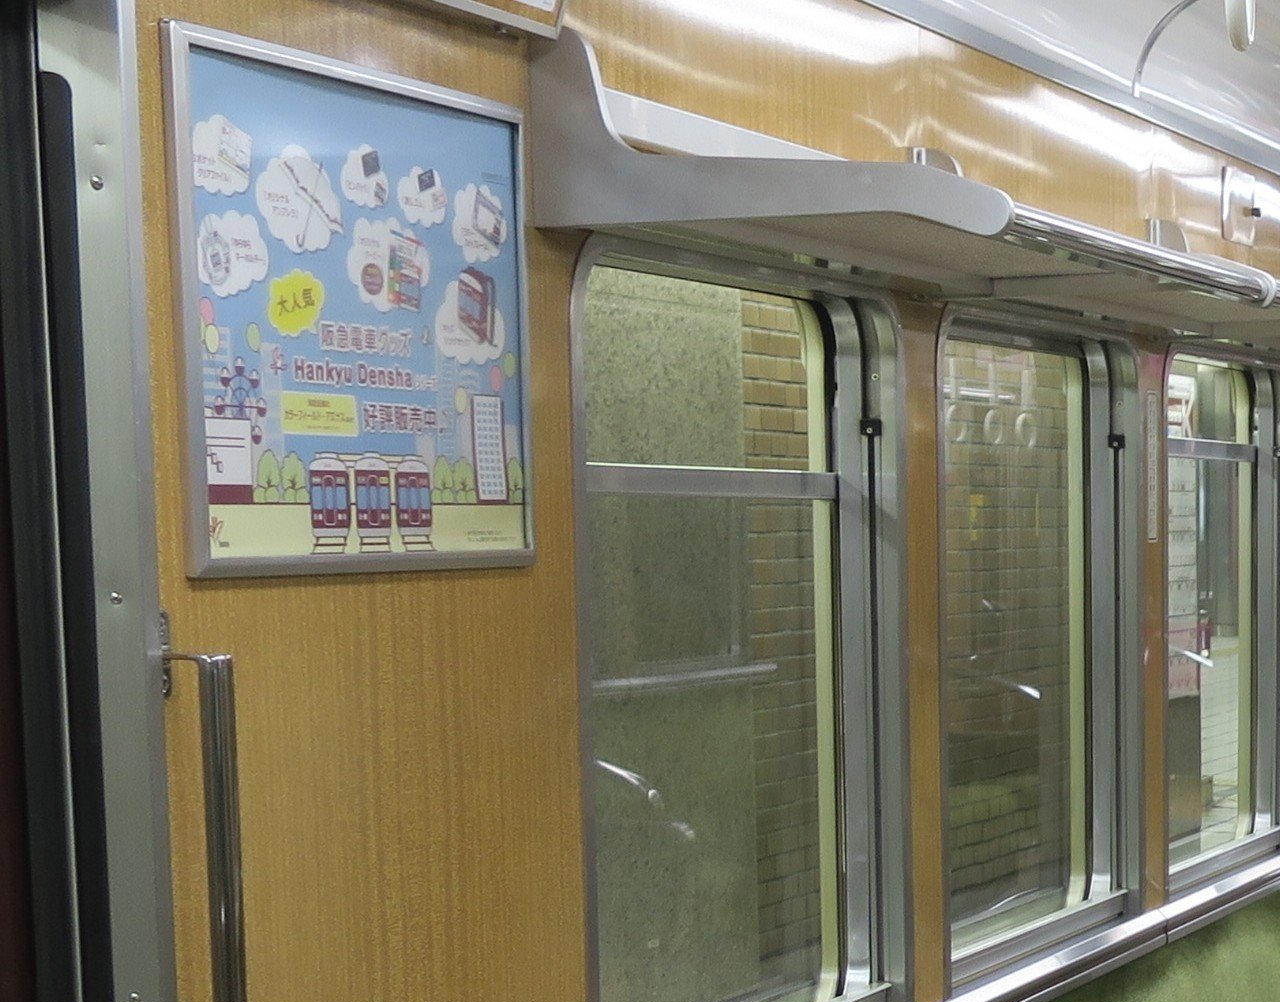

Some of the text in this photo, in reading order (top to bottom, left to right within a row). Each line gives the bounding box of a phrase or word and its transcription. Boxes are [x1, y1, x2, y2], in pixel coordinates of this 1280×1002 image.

[276, 287, 316, 317] 大人気
[293, 355, 353, 387] Hankyu
[357, 362, 414, 389] Densha
[363, 402, 439, 433] 好評販売中
